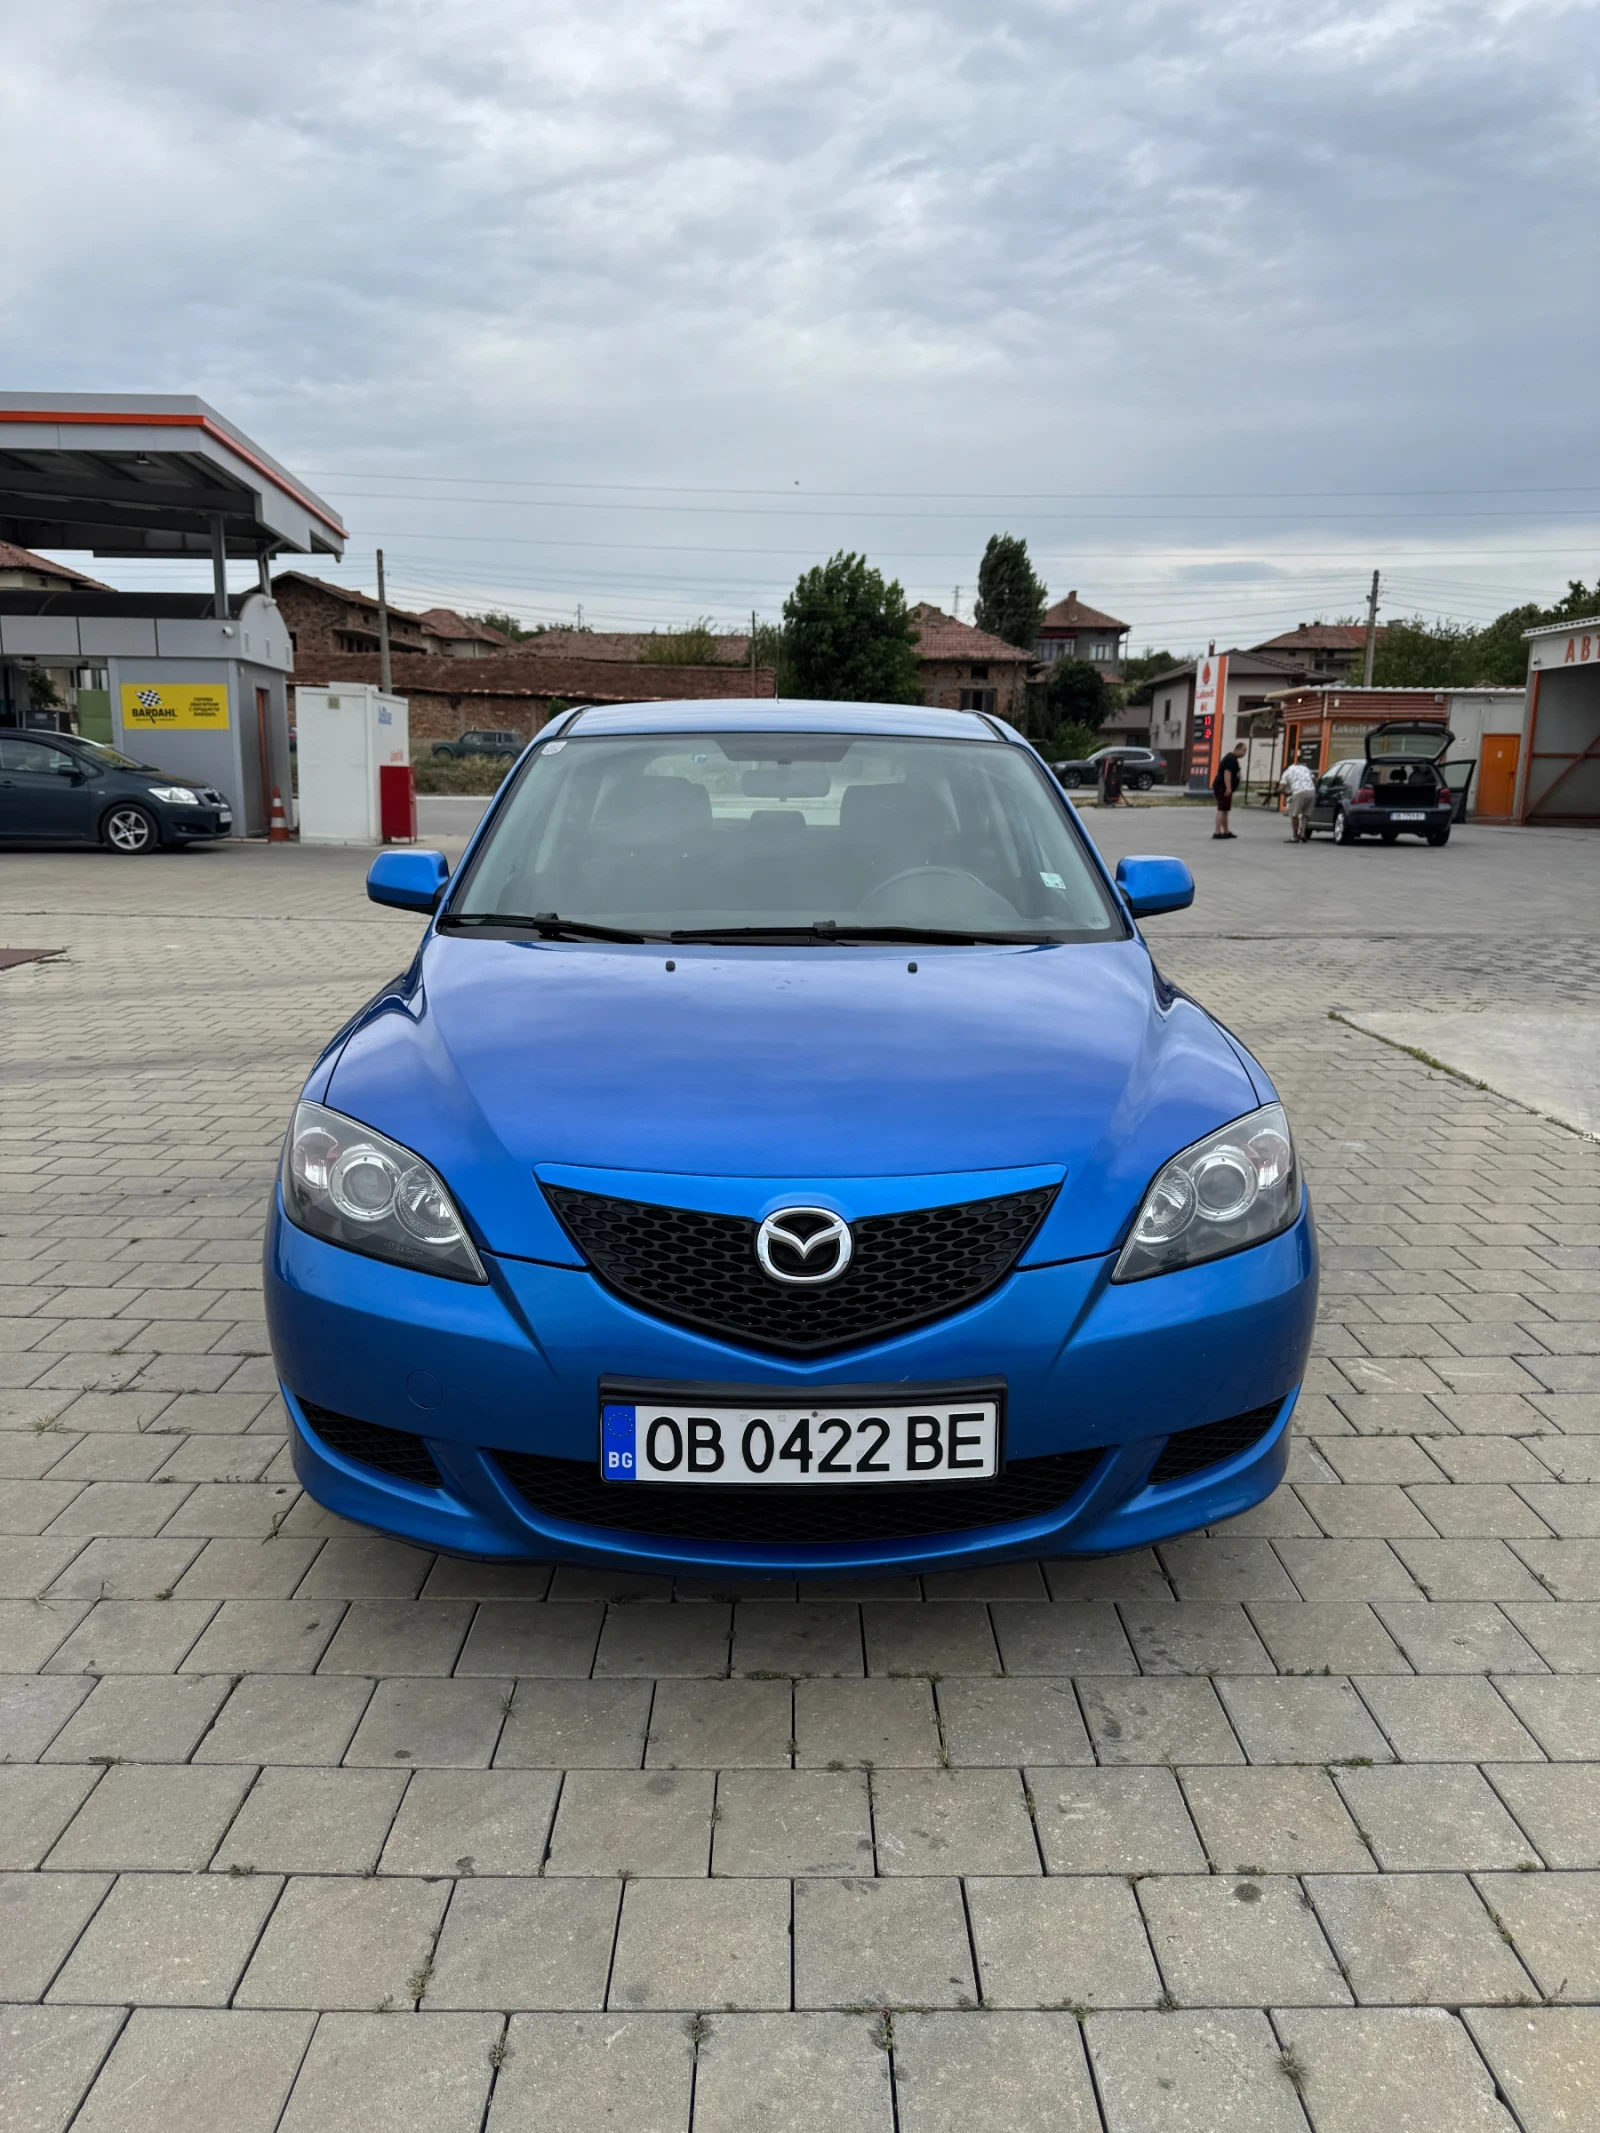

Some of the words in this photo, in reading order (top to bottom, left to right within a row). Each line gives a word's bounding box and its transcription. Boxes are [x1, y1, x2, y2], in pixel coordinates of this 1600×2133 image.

[132, 708, 177, 717] BARDAHL
[646, 1415, 724, 1473] OB
[741, 1416, 891, 1473] 0422
[906, 1412, 985, 1471] BE
[608, 1451, 633, 1469] BG
